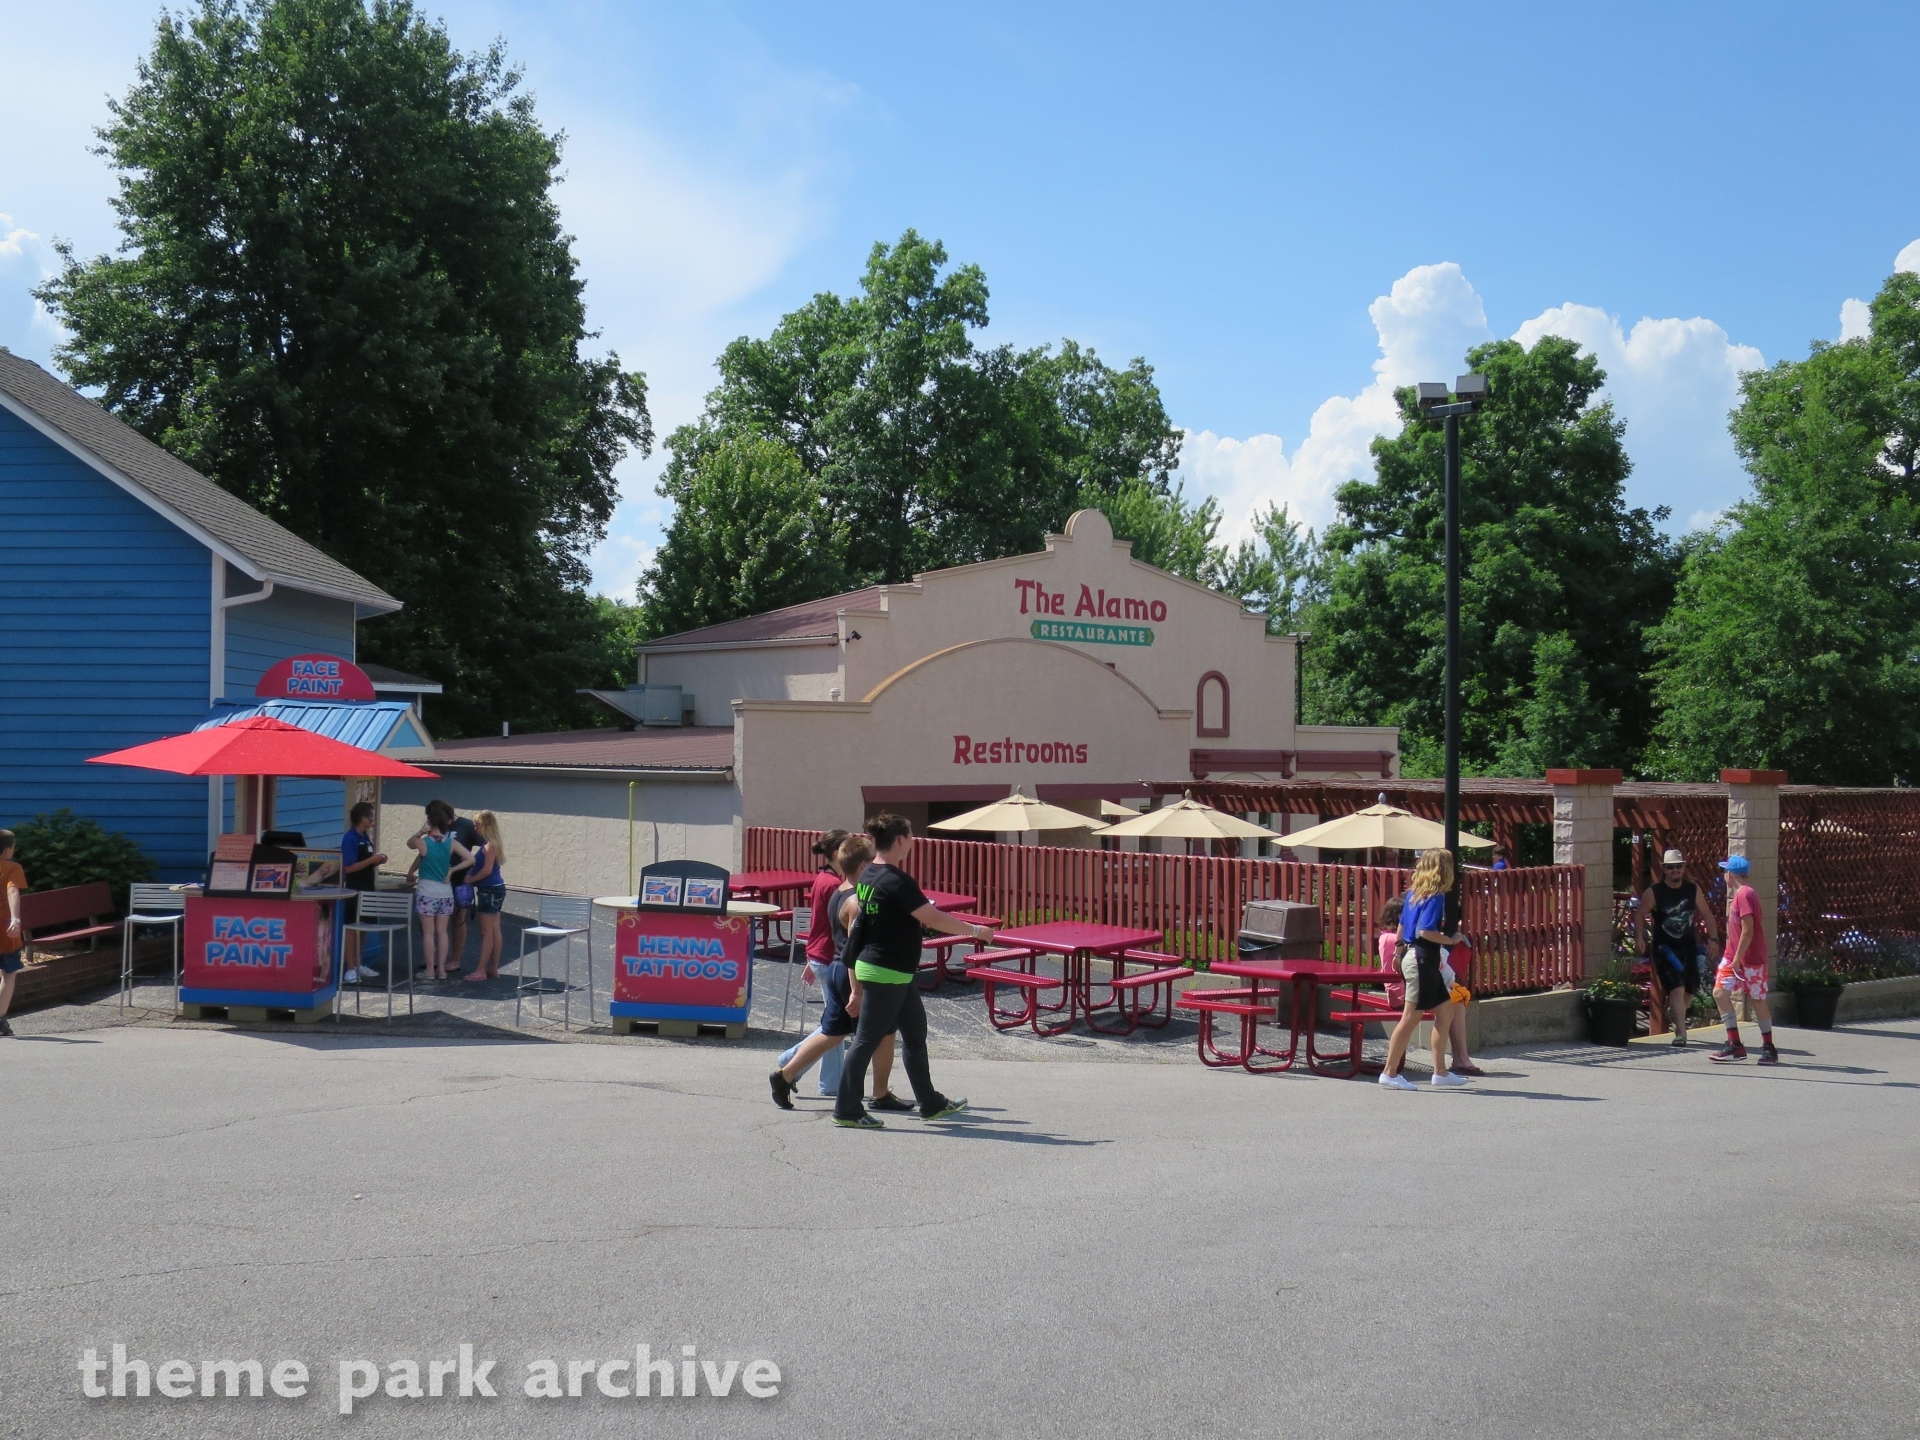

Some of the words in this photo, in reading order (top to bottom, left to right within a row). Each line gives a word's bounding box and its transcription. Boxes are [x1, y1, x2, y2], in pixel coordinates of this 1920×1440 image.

[1014, 578, 1065, 615] The
[1074, 583, 1167, 622] Alamo
[1040, 624, 1145, 643] RESTAURANTE
[292, 660, 339, 676] FACE
[286, 677, 344, 695] PAINT
[953, 735, 1088, 766] Restrooms
[213, 916, 286, 941] FACE
[205, 941, 293, 967] PAINT
[638, 935, 725, 958] HENNA
[622, 956, 739, 981] TATTOOS
